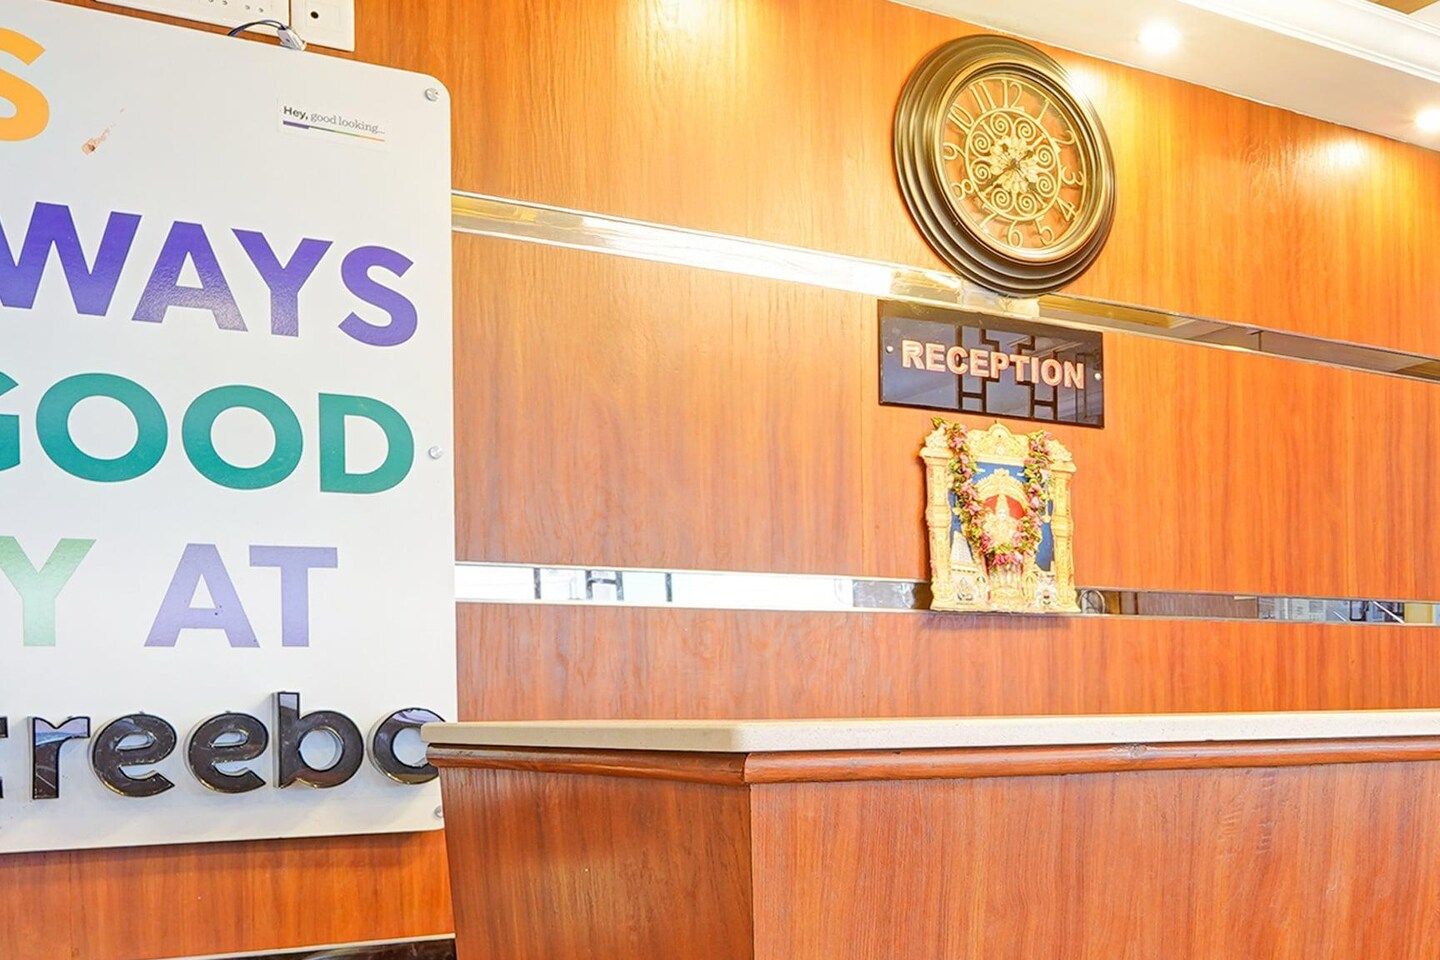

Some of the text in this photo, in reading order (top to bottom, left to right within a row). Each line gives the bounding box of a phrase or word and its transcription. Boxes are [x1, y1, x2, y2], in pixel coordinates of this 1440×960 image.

[283, 105, 308, 120] Hey,
[310, 112, 337, 126] good
[902, 339, 1085, 390] RECEPTION
[144, 543, 338, 648] AT
[0, 691, 446, 801] reebo
